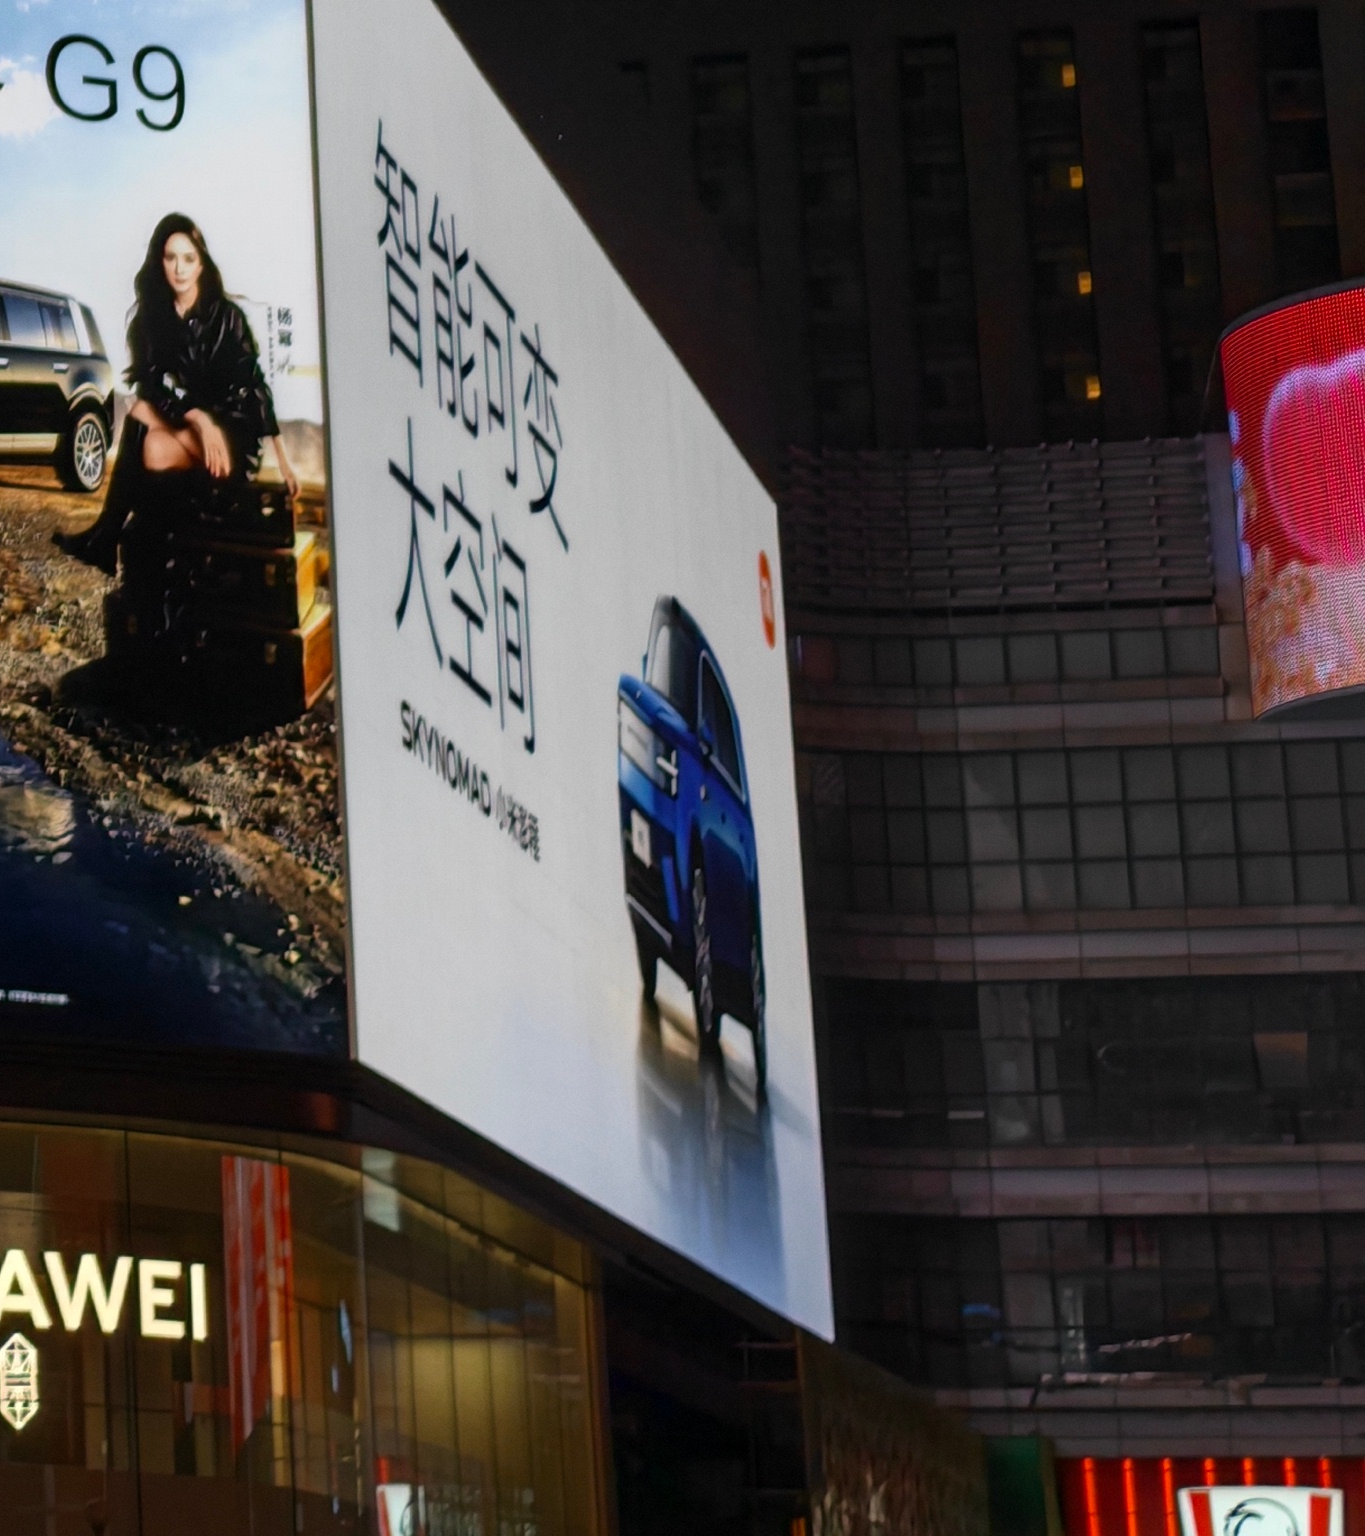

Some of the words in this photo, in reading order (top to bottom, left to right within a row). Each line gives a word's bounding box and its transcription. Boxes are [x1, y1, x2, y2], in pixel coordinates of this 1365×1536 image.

[46, 34, 187, 132] G9
[373, 119, 569, 552] 智能可变
[388, 417, 537, 754] 大空间
[400, 699, 491, 818] SKYNOMAD
